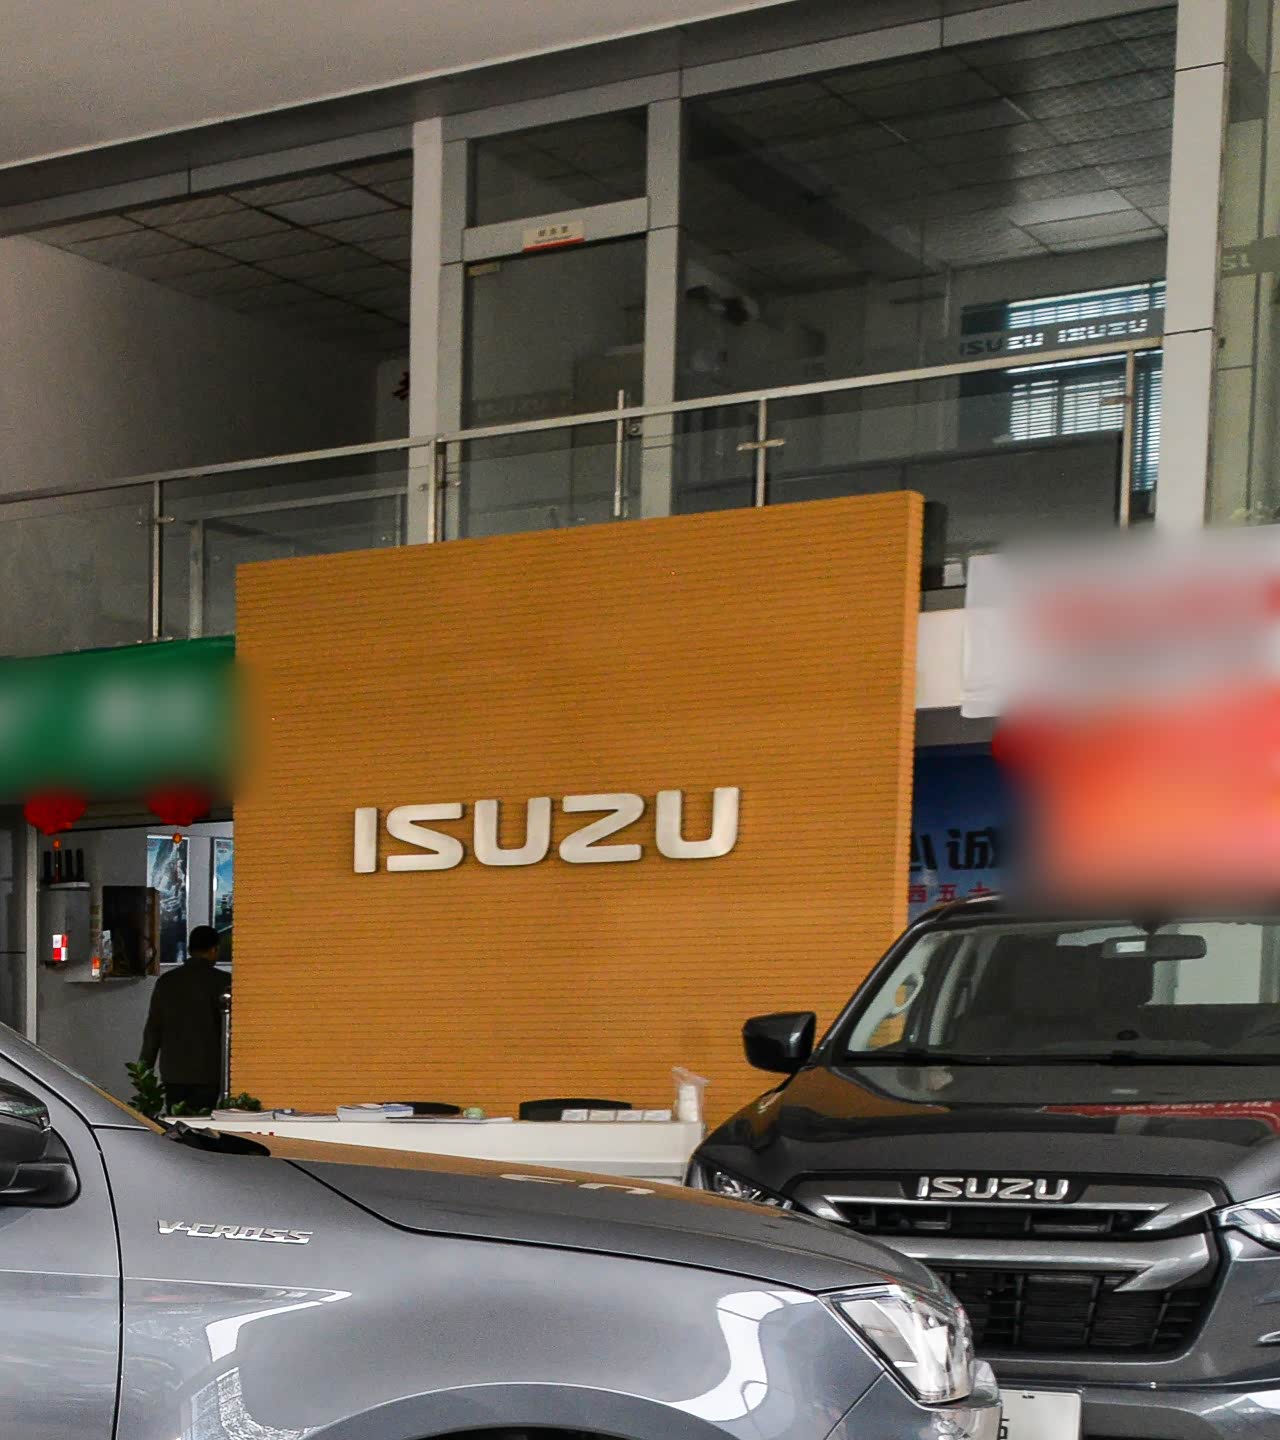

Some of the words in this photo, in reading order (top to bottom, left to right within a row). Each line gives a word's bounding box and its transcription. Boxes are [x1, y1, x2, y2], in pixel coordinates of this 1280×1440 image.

[353, 786, 740, 874] ISUZU
[916, 1176, 1069, 1200] ISUZU
[157, 1219, 314, 1245] V-CROSS
